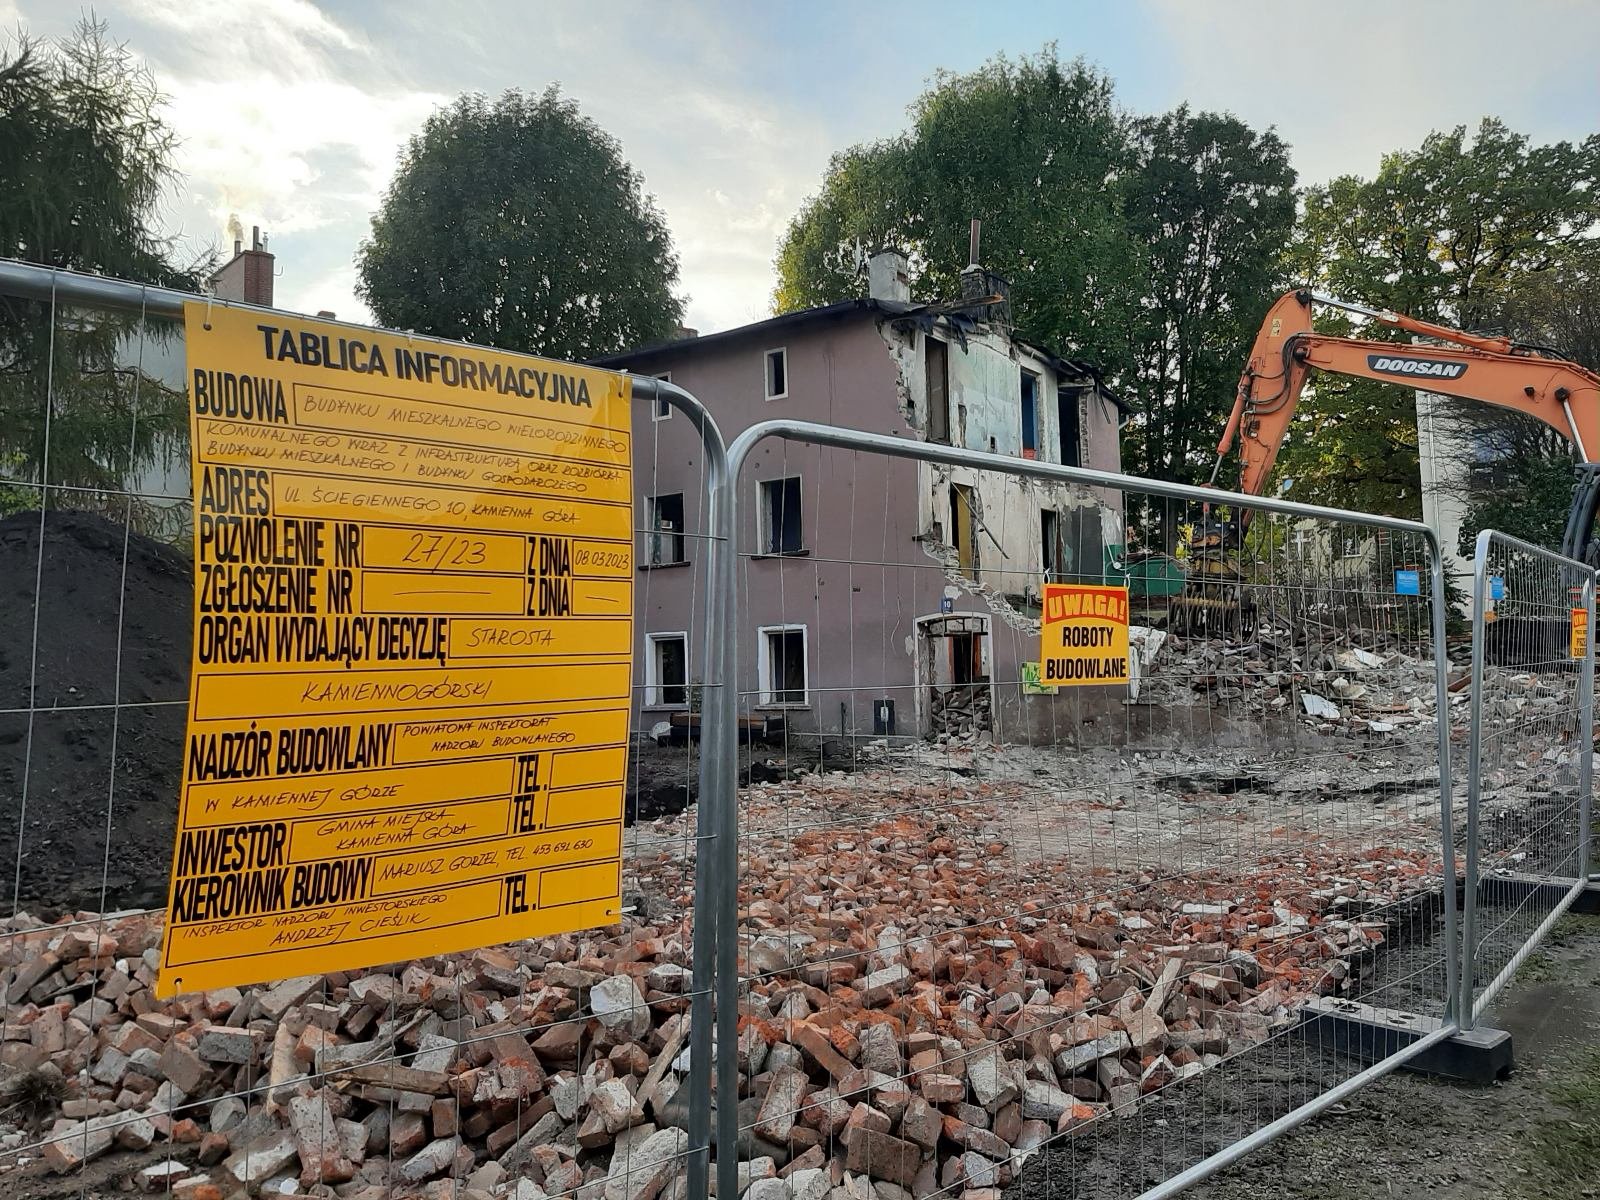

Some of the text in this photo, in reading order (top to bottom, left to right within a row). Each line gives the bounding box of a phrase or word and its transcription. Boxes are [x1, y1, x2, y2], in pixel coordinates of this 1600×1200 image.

[257, 325, 592, 408] TABLICA INFORMACYJNA
[1373, 358, 1461, 377] DOOSAN
[194, 368, 289, 425] BUDOWA
[303, 395, 381, 418] BUDYNKU
[387, 408, 501, 431] MIESZKALNEGO
[206, 422, 340, 448] KOMUNALNEGO
[347, 438, 389, 454] WRAZ
[398, 444, 408, 457] Z
[527, 461, 559, 474] ORAZ
[206, 440, 276, 459] BUDYNKU
[280, 448, 396, 472] MIESZKALNEGO
[417, 464, 475, 480] BUDYNKU
[481, 471, 588, 493] GOSPODARCZEGO
[200, 466, 270, 517] ADRES
[311, 485, 441, 512] ŚCIEGIENNEGO
[471, 503, 535, 520] KAMIENNA
[543, 508, 581, 525] GÓRA
[200, 515, 360, 568] POZWOLENIE NR
[402, 532, 487, 574] 27/23
[527, 536, 571, 577] Z DNIA
[200, 564, 353, 614] ZGŁOSZENIE NR
[527, 577, 571, 616] Z DNIA
[944, 600, 951, 608] 10
[1048, 593, 1126, 620] UWAGA!
[199, 615, 447, 669] ORGAN WYDAJĄCY DECYZJĘ
[466, 627, 556, 647] STAROSTA
[1062, 626, 1114, 647] ROBOTY
[1046, 657, 1126, 680] BUDOWLANE
[301, 675, 493, 703] KAMIENNOGÓRSKI
[402, 717, 558, 738] POWIATOWY INSPEKTORAT
[431, 732, 576, 752] NADZORU BUDOWLANEGO
[188, 720, 393, 781] NADZÓR BUDOWLANY
[517, 754, 548, 794] TEL.
[205, 784, 404, 814] W KAMIENNEJ GÓRZE
[513, 793, 543, 834] TEL.
[317, 808, 456, 836] GMINA MIEJSKA
[336, 823, 477, 850] KAMIENNA GÓRA
[177, 822, 287, 877] INWESTOR
[378, 858, 445, 882] MARIUSZ
[532, 843, 551, 856] 453
[553, 842, 570, 853] 691
[573, 838, 593, 850] 630
[171, 856, 373, 924] KIEROWNIK BUDOWY
[505, 873, 536, 915] TEL.
[182, 894, 448, 939] INSPEKTOR NADZORU INWESTORSKIEGO
[269, 912, 430, 946] ANDRZEJ CIEŚLIK
